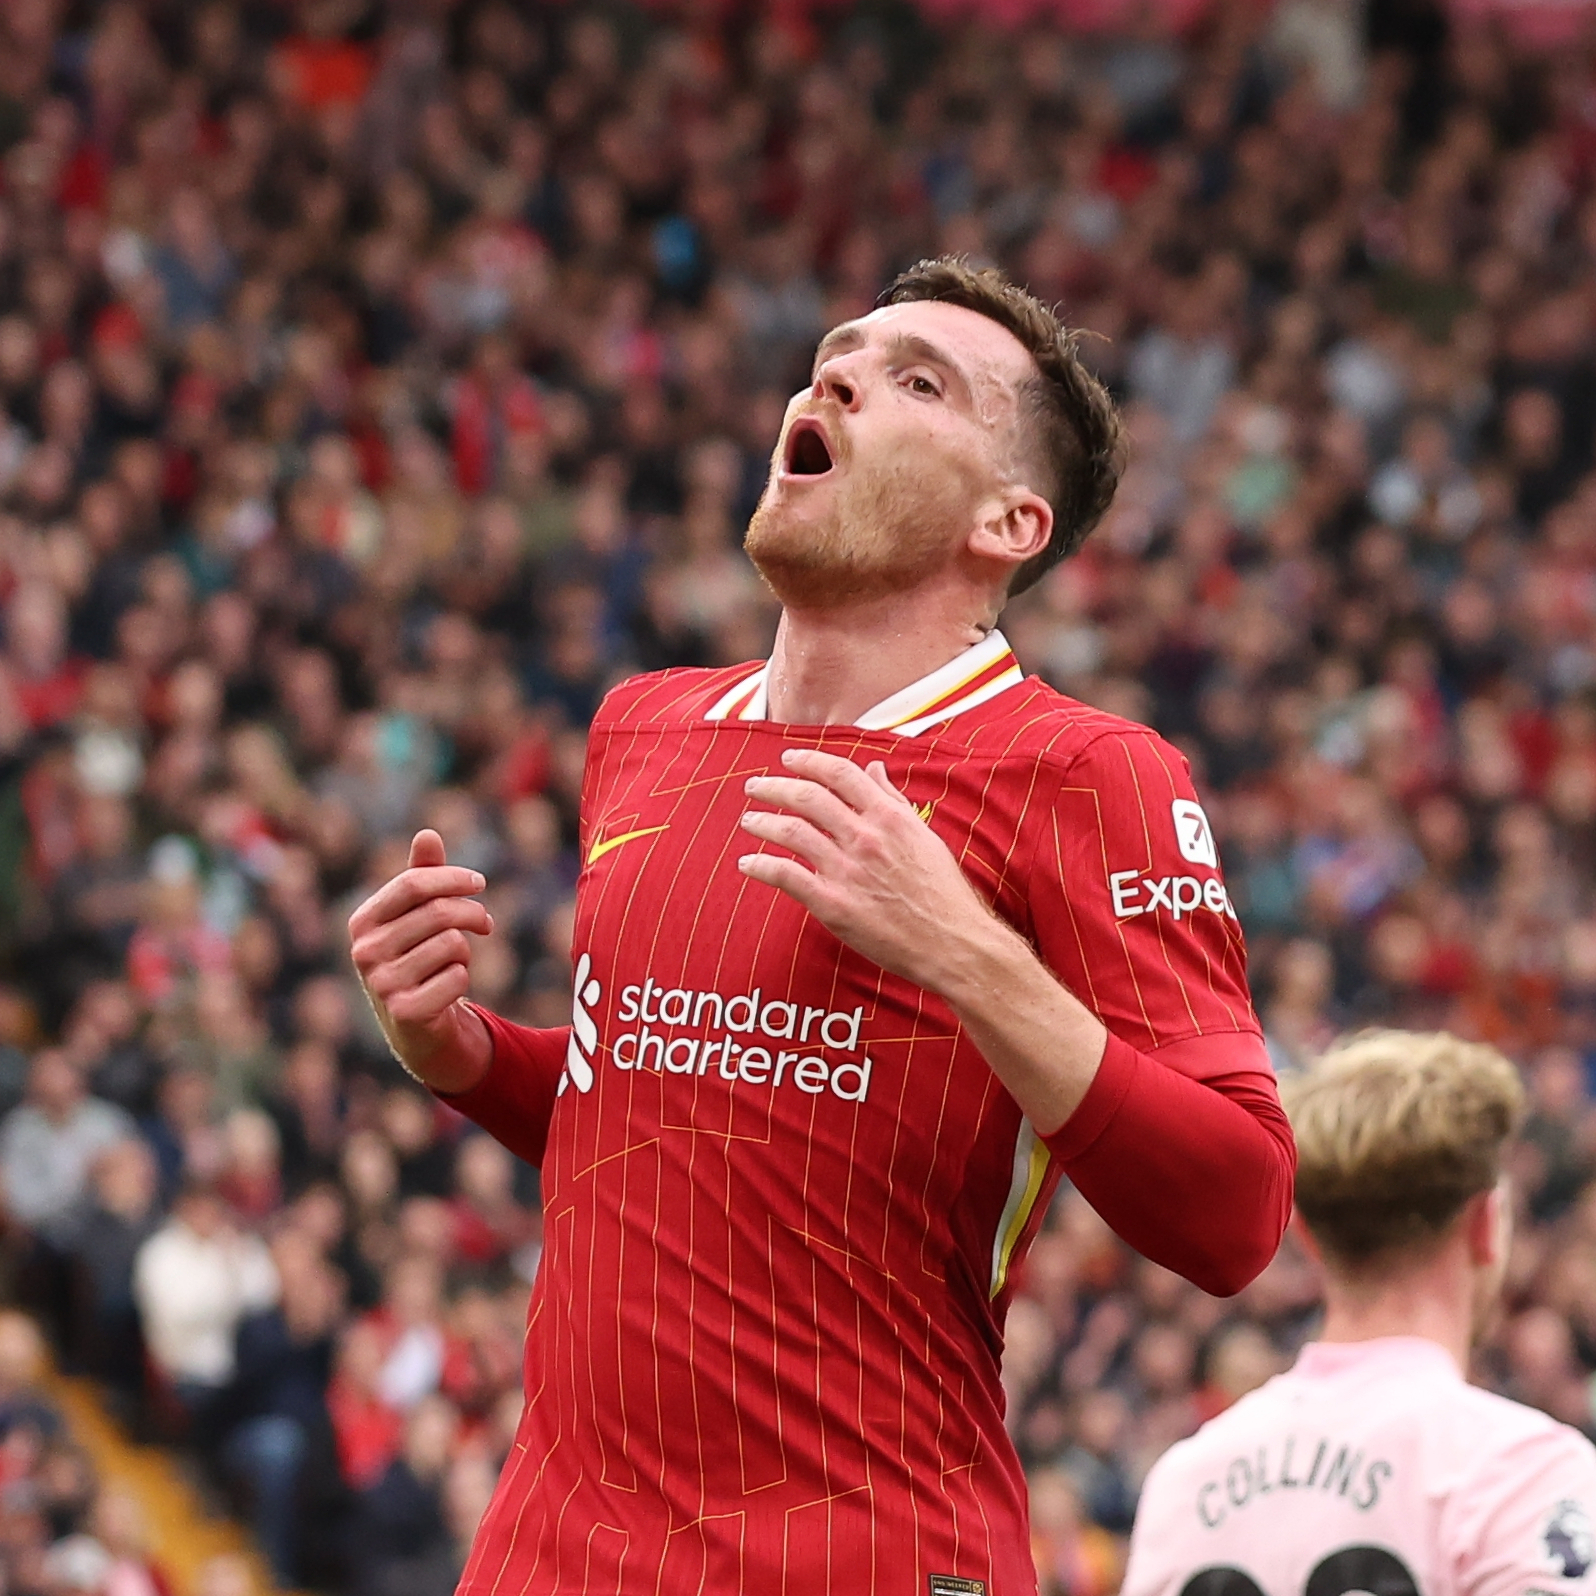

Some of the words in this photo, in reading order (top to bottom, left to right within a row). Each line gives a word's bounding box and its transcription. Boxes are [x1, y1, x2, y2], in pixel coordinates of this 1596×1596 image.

[617, 976, 864, 1052] standard
[611, 1025, 873, 1104] chartered
[1196, 1433, 1392, 1529] COLLINS
